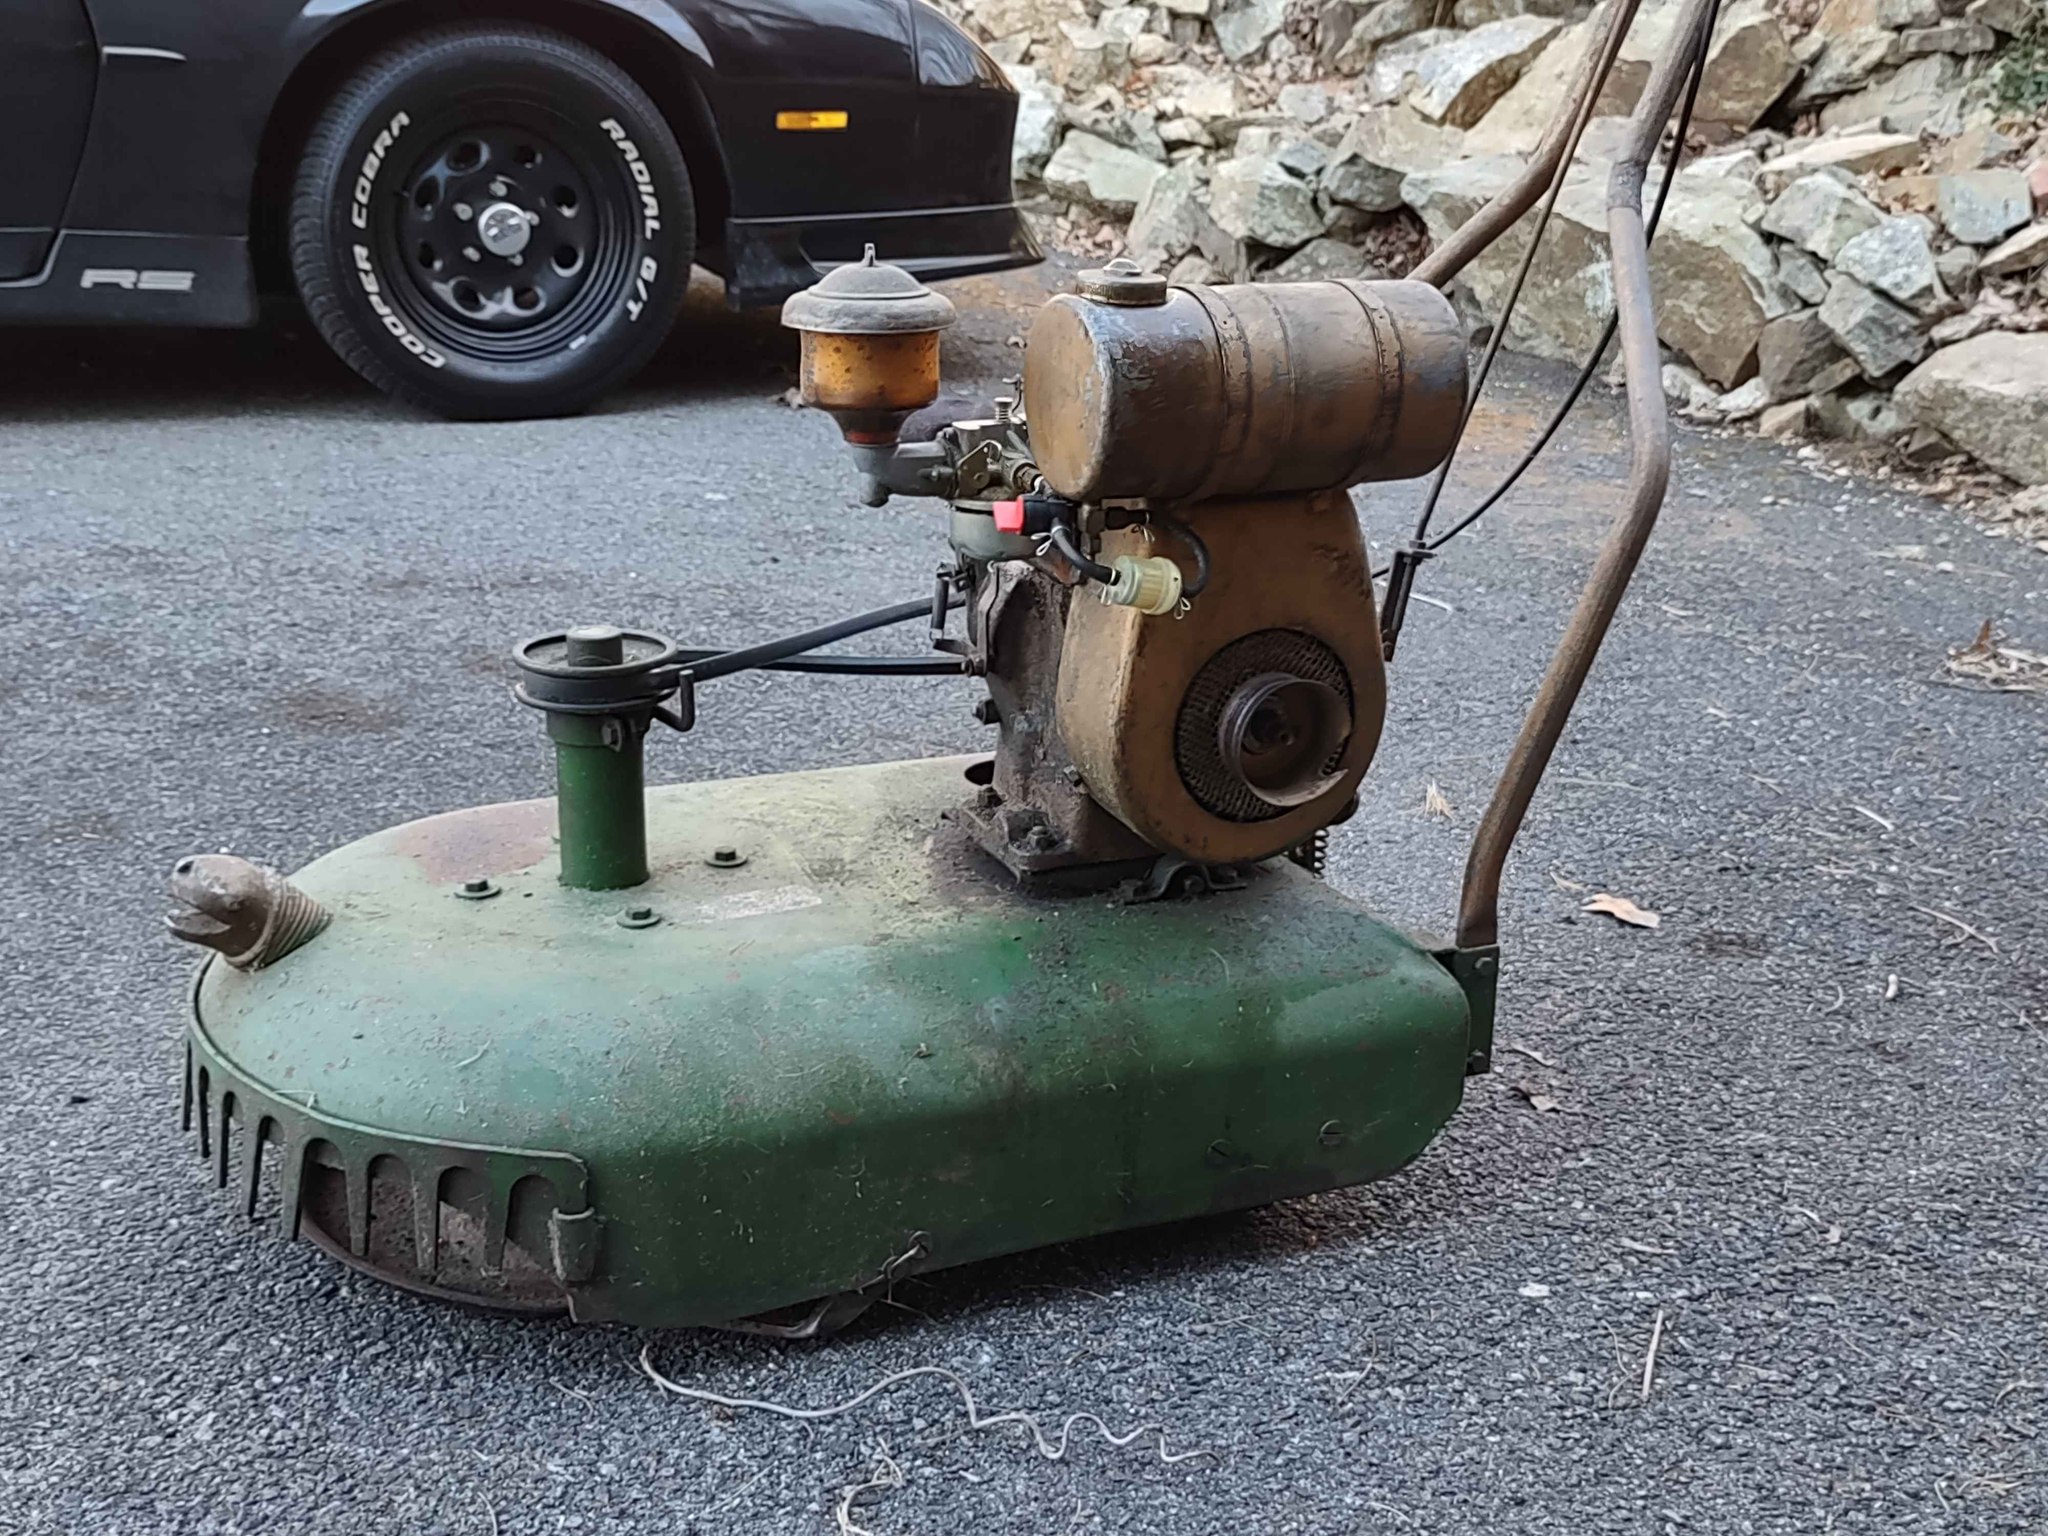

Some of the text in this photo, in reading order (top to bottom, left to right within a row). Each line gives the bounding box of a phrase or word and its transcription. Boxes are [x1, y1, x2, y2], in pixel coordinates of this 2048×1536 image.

[80, 268, 195, 291] RS
[351, 111, 446, 369] COOPER COBRA
[599, 117, 661, 322] RADIAL G/T
